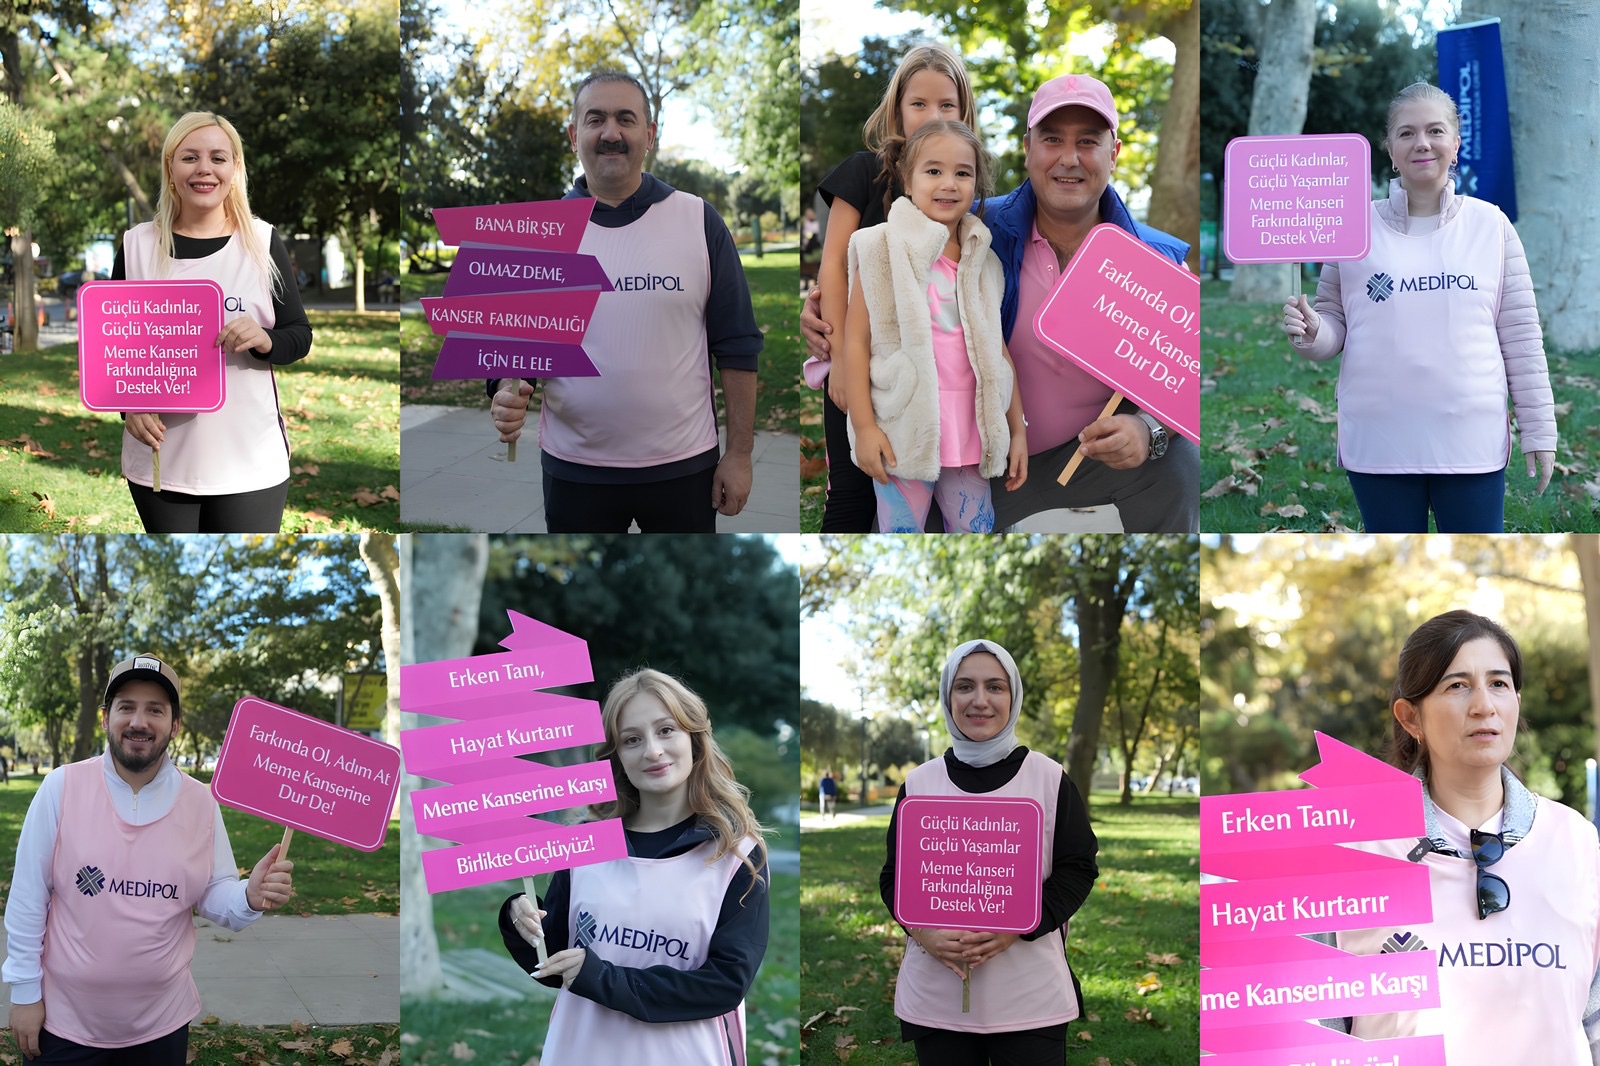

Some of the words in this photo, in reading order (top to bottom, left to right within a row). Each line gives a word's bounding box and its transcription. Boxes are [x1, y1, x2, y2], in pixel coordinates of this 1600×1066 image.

[1248, 154, 1287, 170] Güçlü
[1291, 152, 1349, 168] Kadınlar,
[1248, 175, 1287, 191] Güçlü
[1290, 173, 1349, 190] Yaşamlar
[1250, 197, 1293, 211] Meme
[1296, 195, 1344, 210] Kanseri
[475, 217, 514, 233] BANA
[516, 216, 539, 234] BİR
[540, 221, 565, 239] ŞEY
[1251, 213, 1343, 231] Farkındalığına
[1260, 231, 1306, 245] Destek
[1309, 229, 1336, 245] Ver!
[469, 261, 521, 279] OLMAZ
[523, 265, 566, 284] DEME,
[1399, 271, 1478, 292] MEDİPOL
[1097, 258, 1168, 314] Farkında
[1169, 305, 1195, 333] Ol,
[101, 300, 140, 318] Güçlü
[143, 299, 202, 315] Kadınlar,
[101, 322, 141, 339] Güçlü
[143, 321, 203, 339] Yaşamlar
[431, 308, 483, 324] KANSER
[489, 312, 585, 332] FARKINDALIĞI
[1093, 294, 1149, 340] Meme
[1149, 330, 1200, 377] Kanse
[104, 345, 146, 359] Meme
[149, 345, 198, 359] Kanseri
[477, 349, 509, 370] İÇİN
[512, 355, 527, 370] EL
[530, 357, 553, 371] ELE
[106, 362, 197, 380] Farkındalığına
[1114, 338, 1151, 371] Dur
[1149, 361, 1185, 394] De!
[115, 380, 161, 394] Destek
[164, 379, 191, 394] Ver!
[448, 667, 500, 688] Erken
[502, 662, 545, 681] Tanı,
[450, 733, 504, 757] Hayat
[506, 723, 575, 745] Kurtarır
[249, 725, 308, 758] Farkında
[311, 746, 331, 767] Ol,
[333, 754, 372, 780] Adım
[372, 768, 391, 786] At
[253, 754, 300, 782] Meme
[302, 770, 371, 806] Kanserine
[278, 784, 308, 804] Dur
[308, 794, 335, 816] De!
[422, 799, 479, 820] Meme
[481, 785, 564, 810] Kanserine
[566, 776, 608, 796] Karşı
[920, 815, 959, 833] Güçlü
[962, 816, 1021, 834] Kadınlar,
[1221, 808, 1292, 835] Erken
[1296, 804, 1356, 830] Tanı,
[455, 852, 513, 875] Birlikte
[514, 834, 596, 864] Güçlüyüz!
[919, 837, 959, 855] Güçlü
[961, 838, 1022, 856] Yaşamlar
[920, 860, 963, 876] Meme
[966, 862, 1015, 878] Kanseri
[108, 879, 179, 900] MEDİPOL
[921, 878, 1013, 899] Farkındalığına
[930, 896, 976, 912] Destek
[978, 898, 1005, 914] Ver!
[1211, 900, 1286, 931] Hayat
[1292, 894, 1389, 920] Kurtarır
[598, 923, 690, 961] MEDİPOL
[1438, 937, 1567, 970] MEDİPOL
[1200, 990, 1240, 1011] me
[1245, 976, 1365, 1007] Kanserine
[1370, 972, 1428, 998] Karşı
